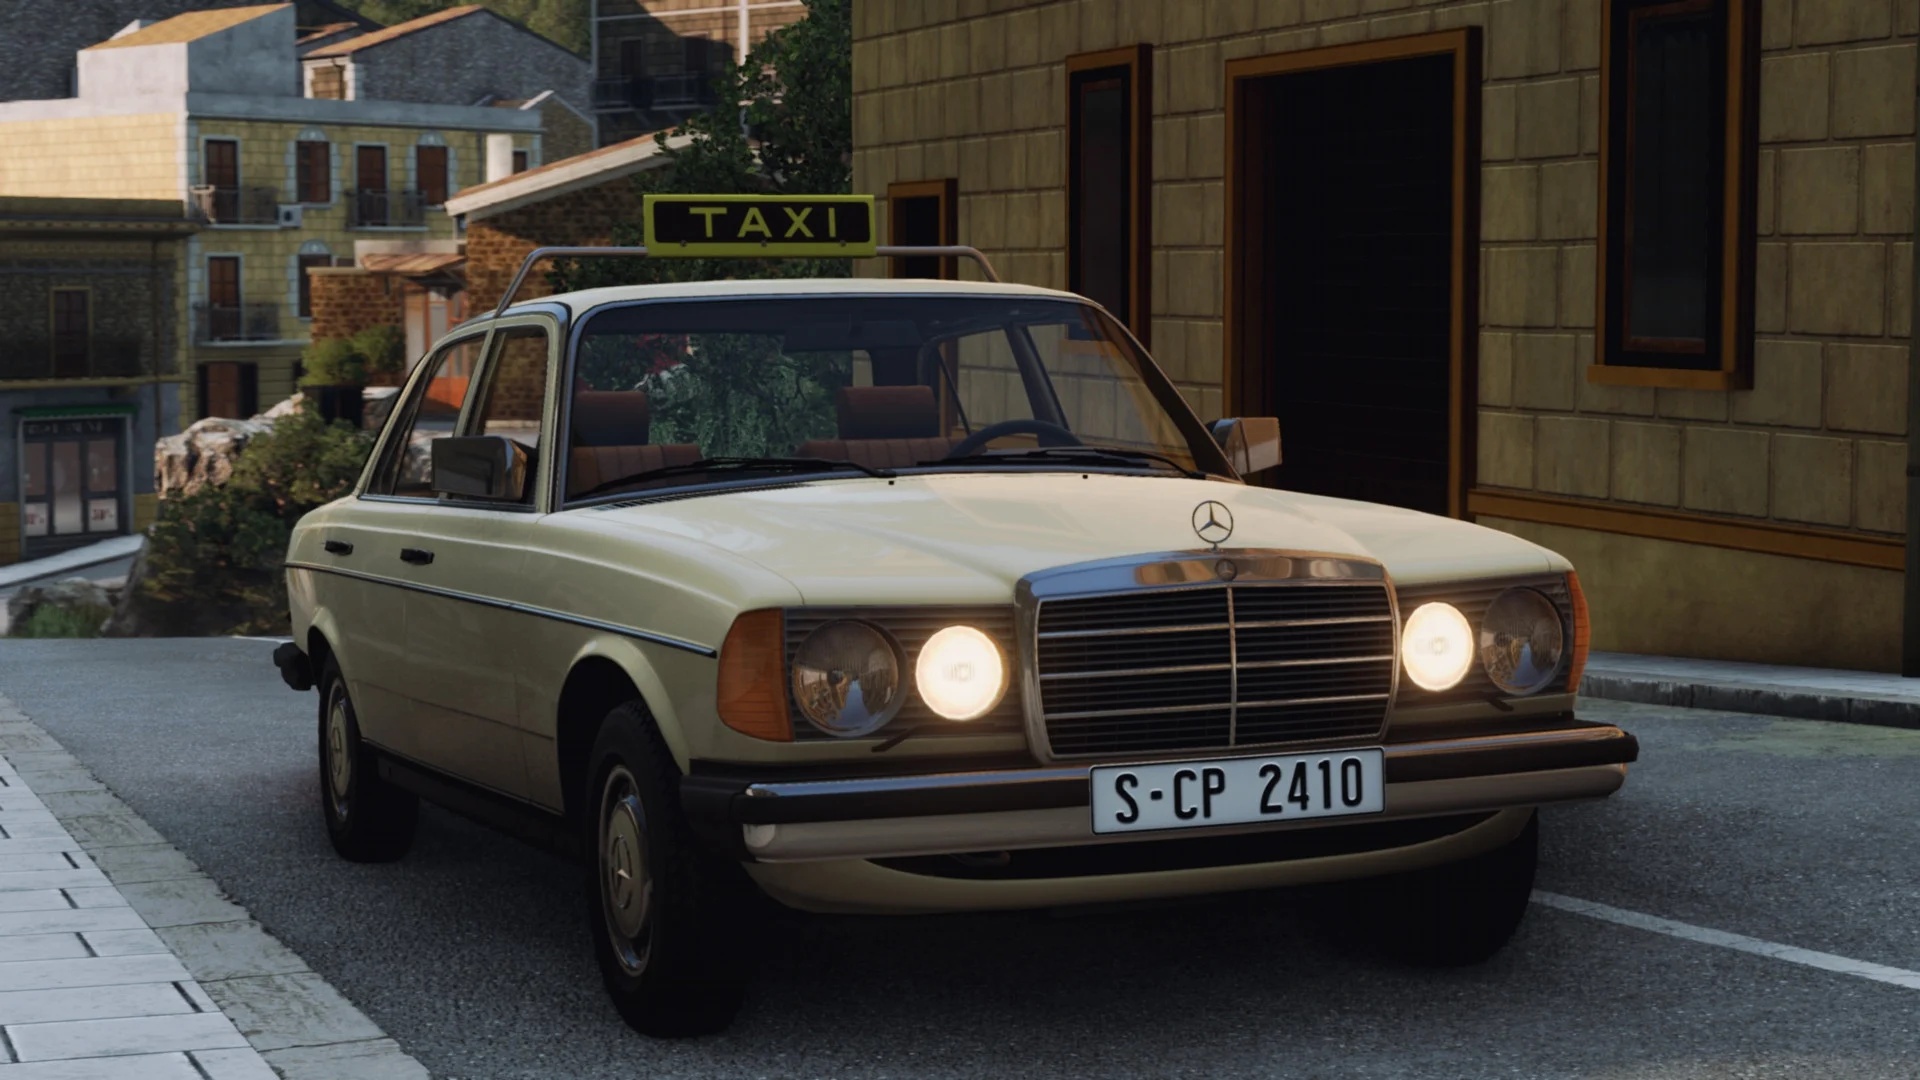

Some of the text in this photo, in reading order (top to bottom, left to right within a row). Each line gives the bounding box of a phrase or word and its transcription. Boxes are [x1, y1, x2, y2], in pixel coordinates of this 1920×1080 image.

[689, 207, 837, 238] TAXI
[1114, 756, 1363, 824] S-CP 2410
